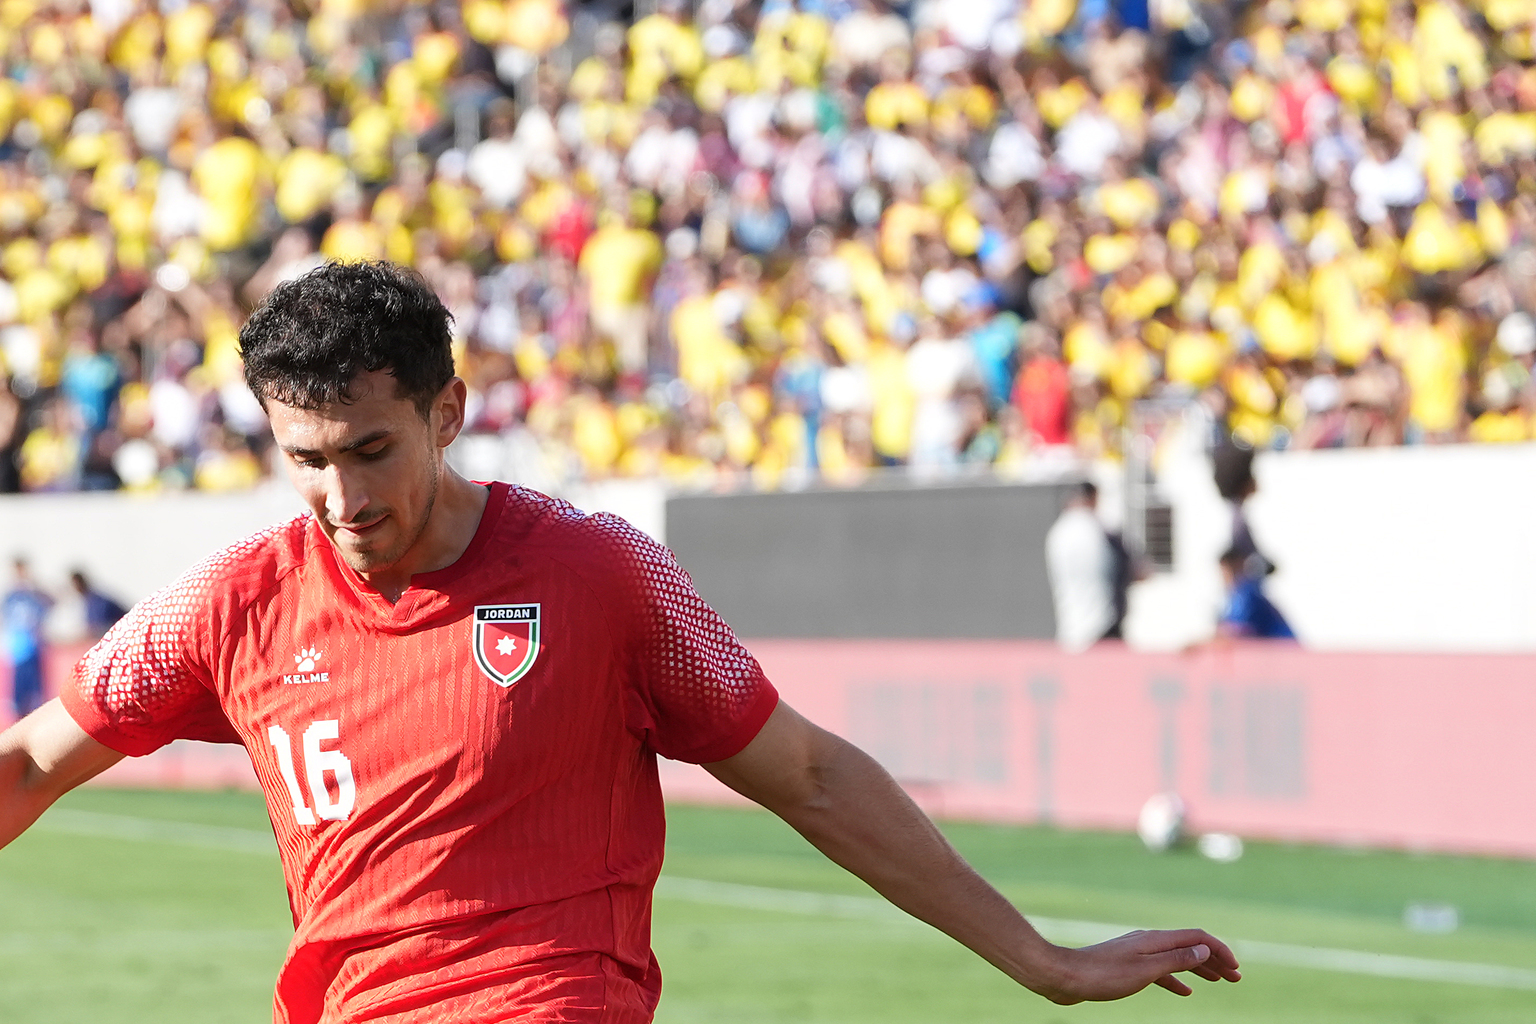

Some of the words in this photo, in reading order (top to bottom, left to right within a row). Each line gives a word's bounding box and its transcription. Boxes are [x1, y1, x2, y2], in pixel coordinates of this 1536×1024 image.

[483, 608, 531, 619] JORDAN
[283, 672, 330, 685] KELME
[268, 719, 356, 825] 16
